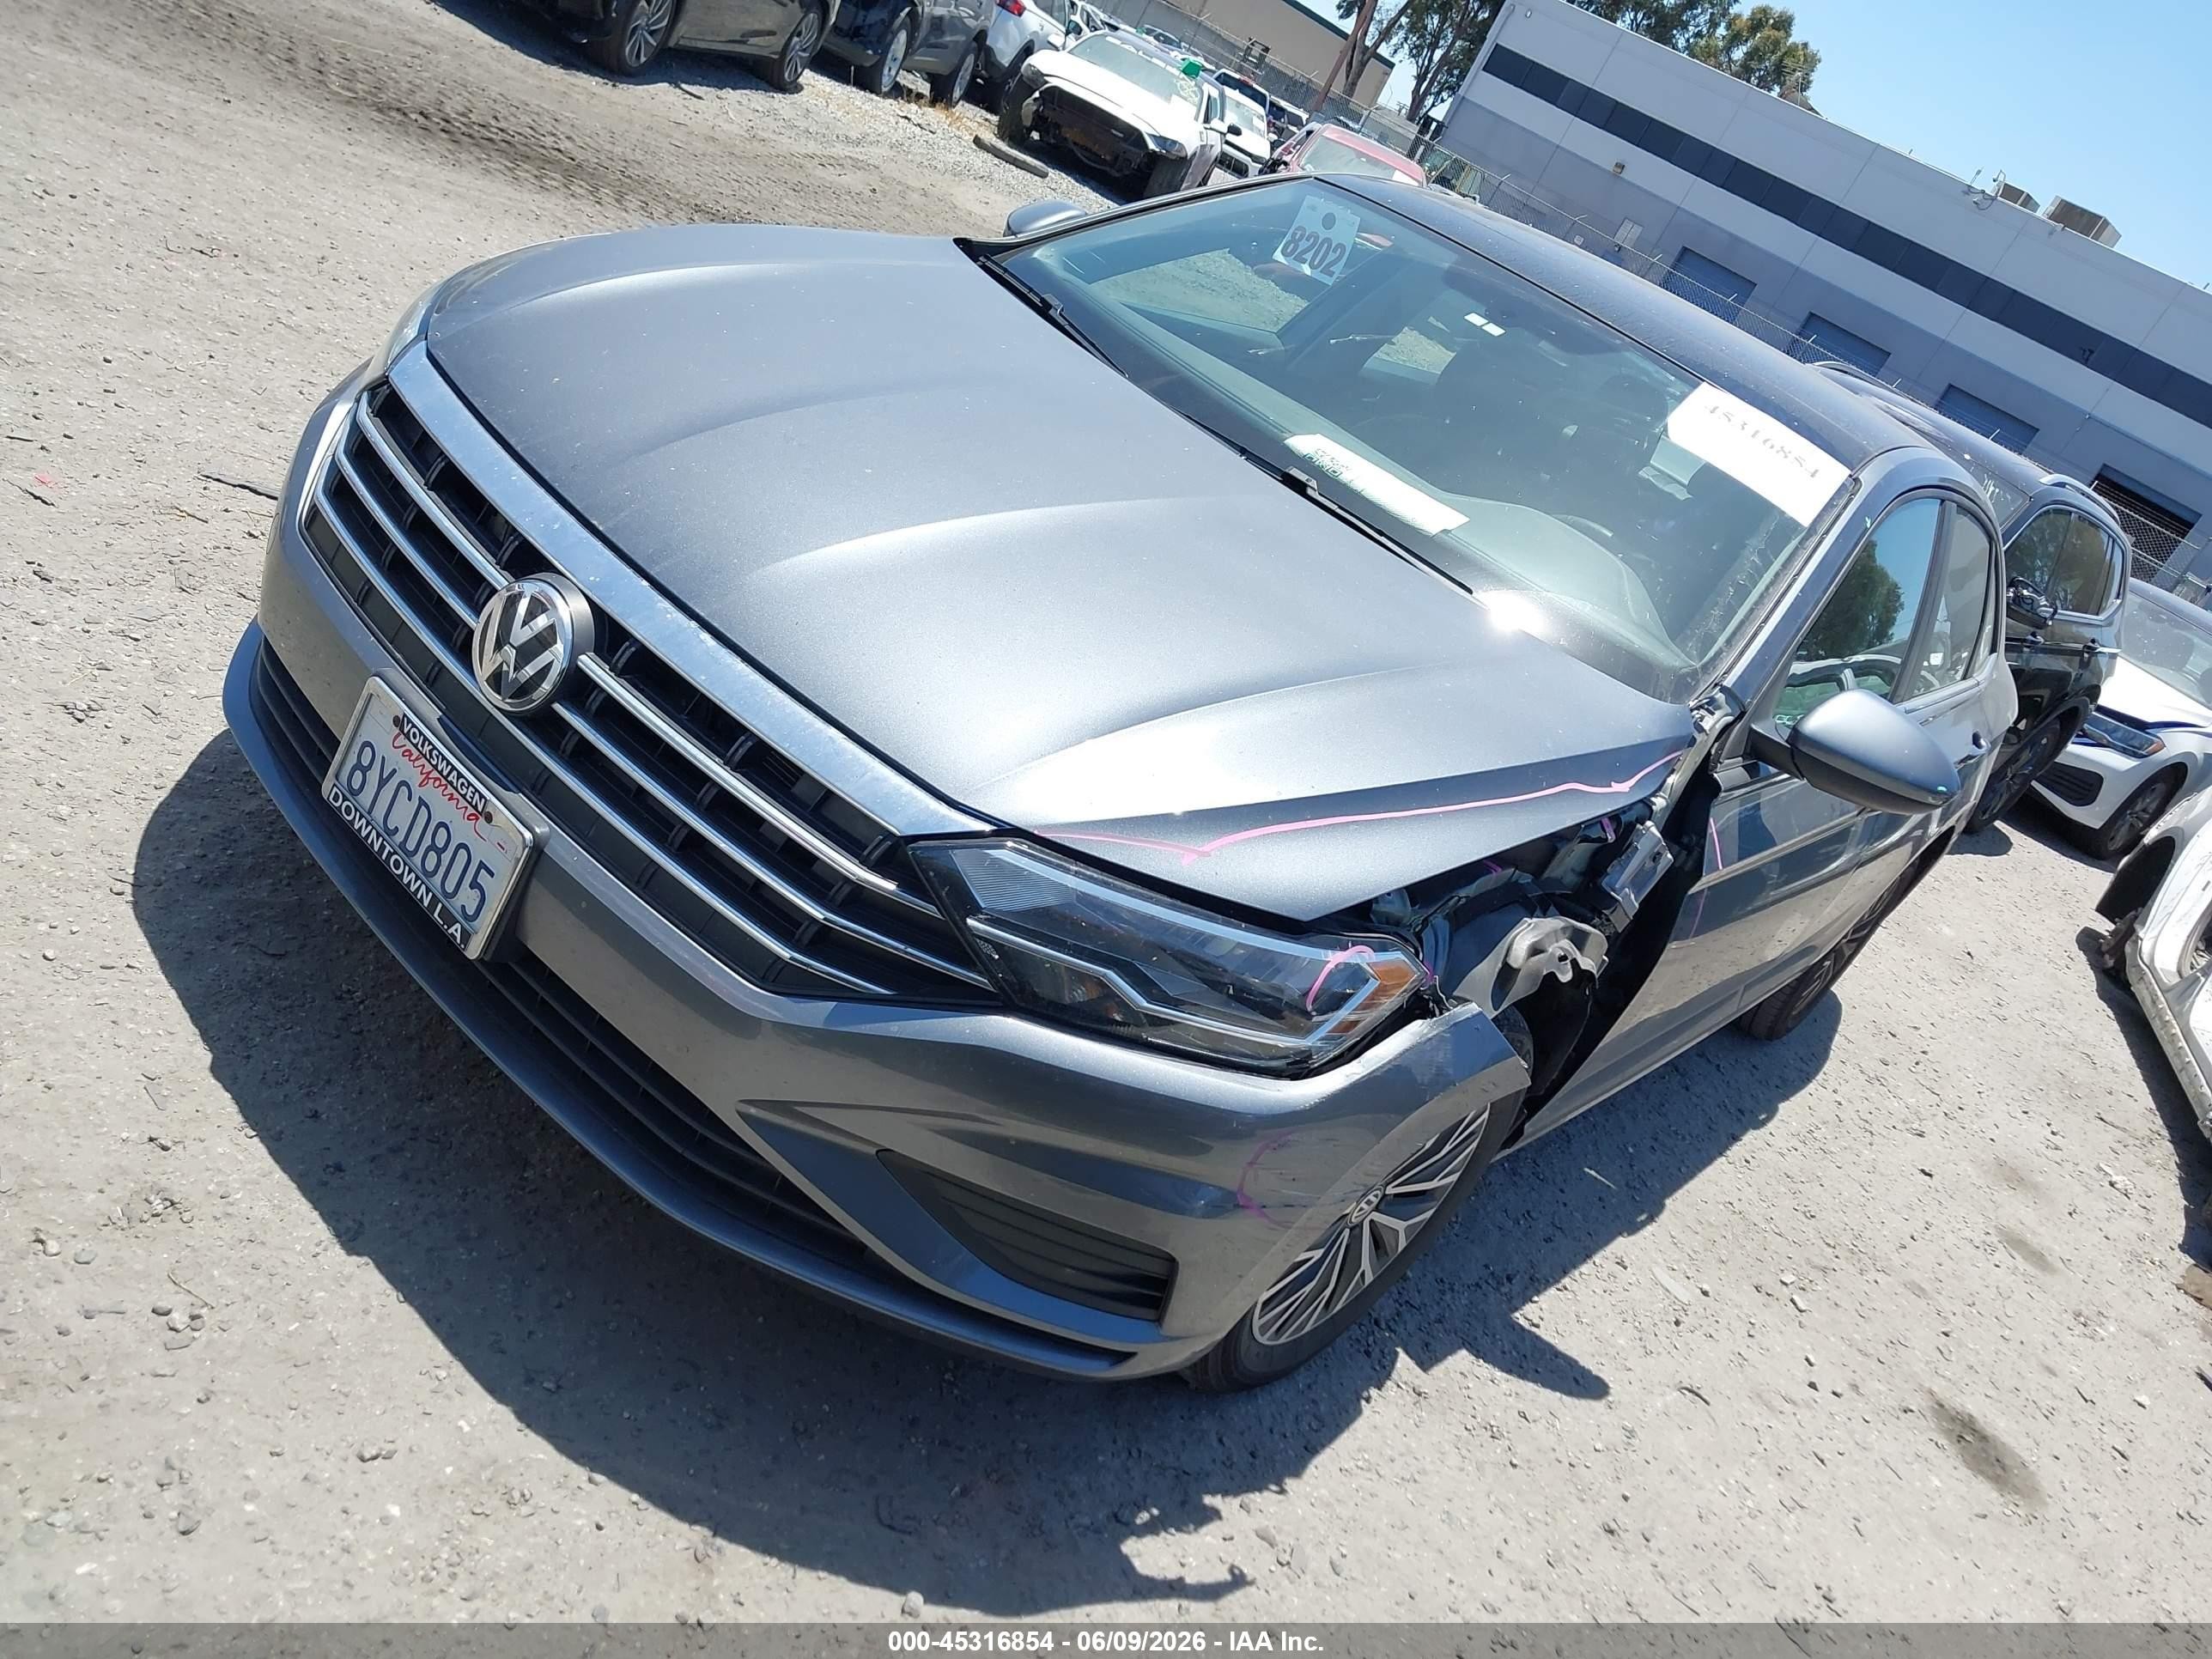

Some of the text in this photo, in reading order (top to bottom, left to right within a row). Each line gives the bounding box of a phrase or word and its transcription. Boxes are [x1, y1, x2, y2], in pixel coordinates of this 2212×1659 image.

[1280, 225, 1346, 278] 8202
[392, 730, 488, 843] California
[400, 716, 487, 814] VOLKSWAGEN
[328, 786, 466, 950] DOWNTOWN L.A.
[346, 740, 495, 923] 8YCD805
